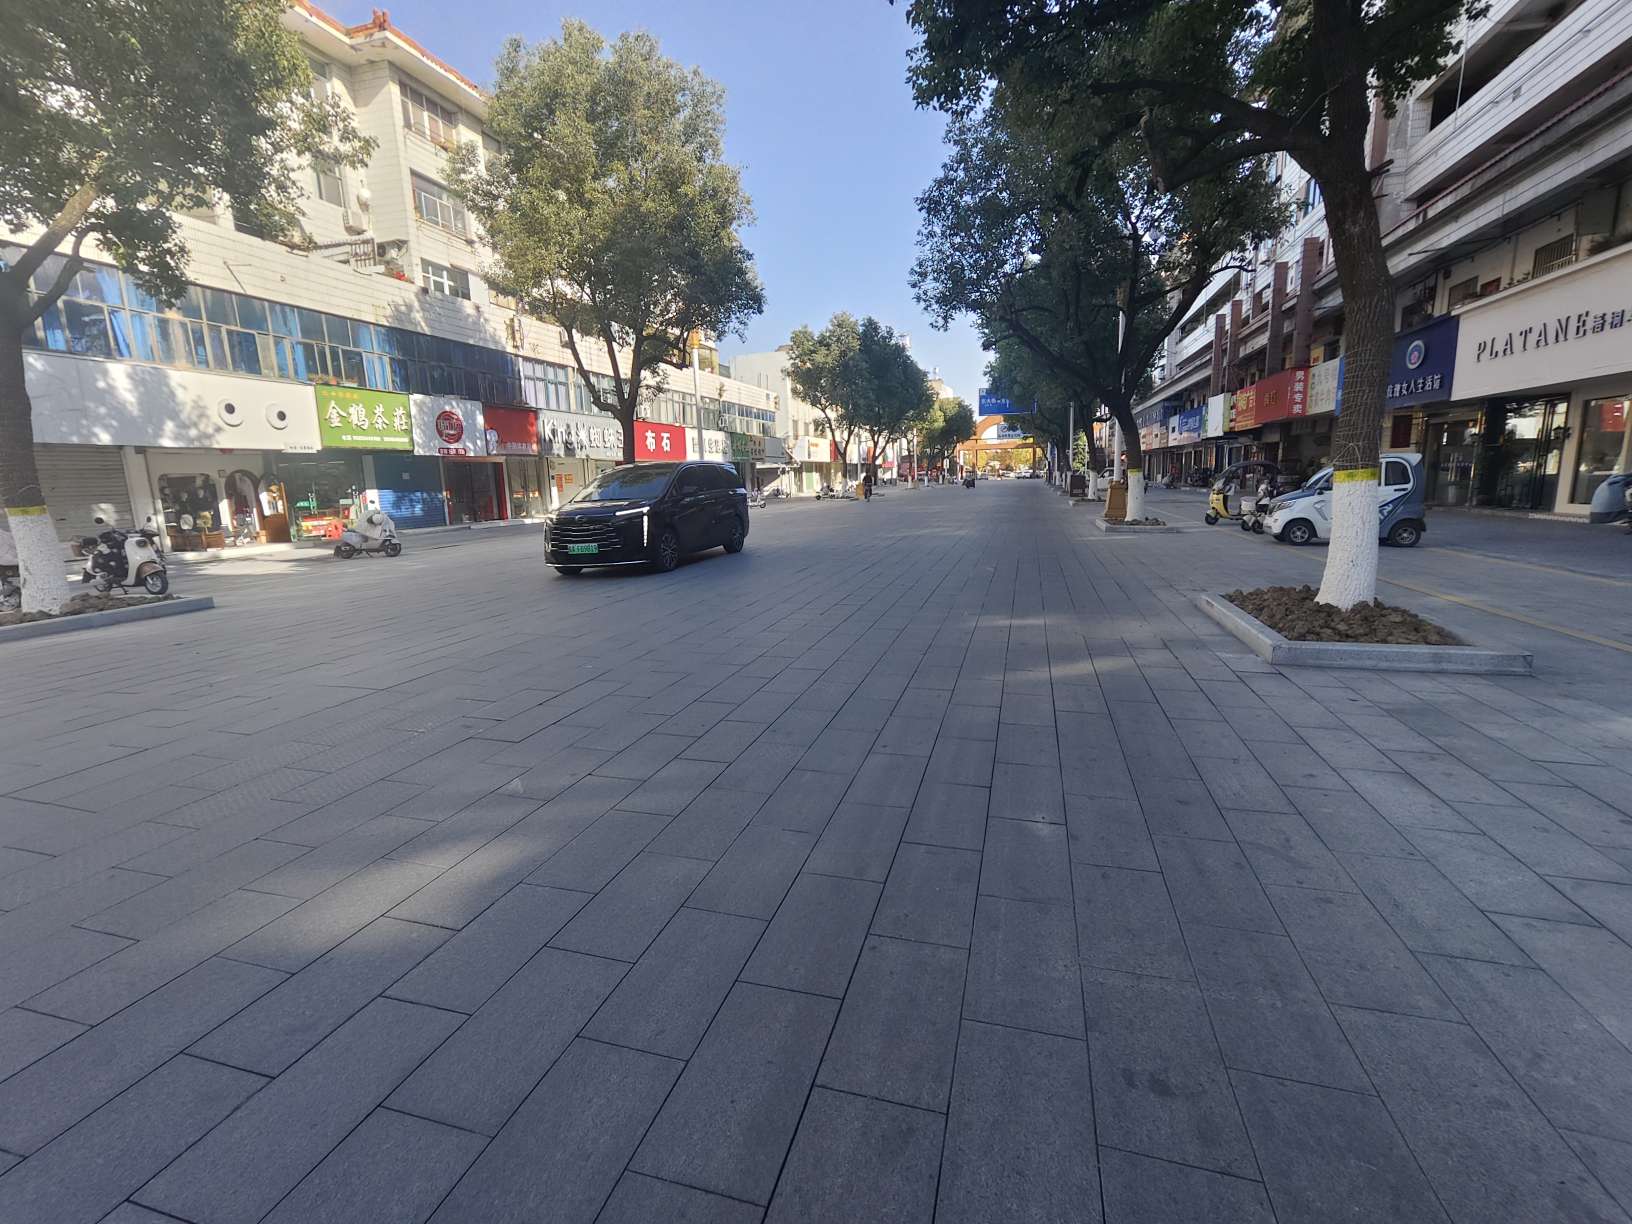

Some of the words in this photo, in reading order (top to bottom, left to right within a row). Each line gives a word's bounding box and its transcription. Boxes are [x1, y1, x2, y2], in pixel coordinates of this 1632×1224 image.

[1475, 310, 1590, 363] PLATANE
[543, 418, 574, 449] King
[644, 429, 671, 453] 布石
